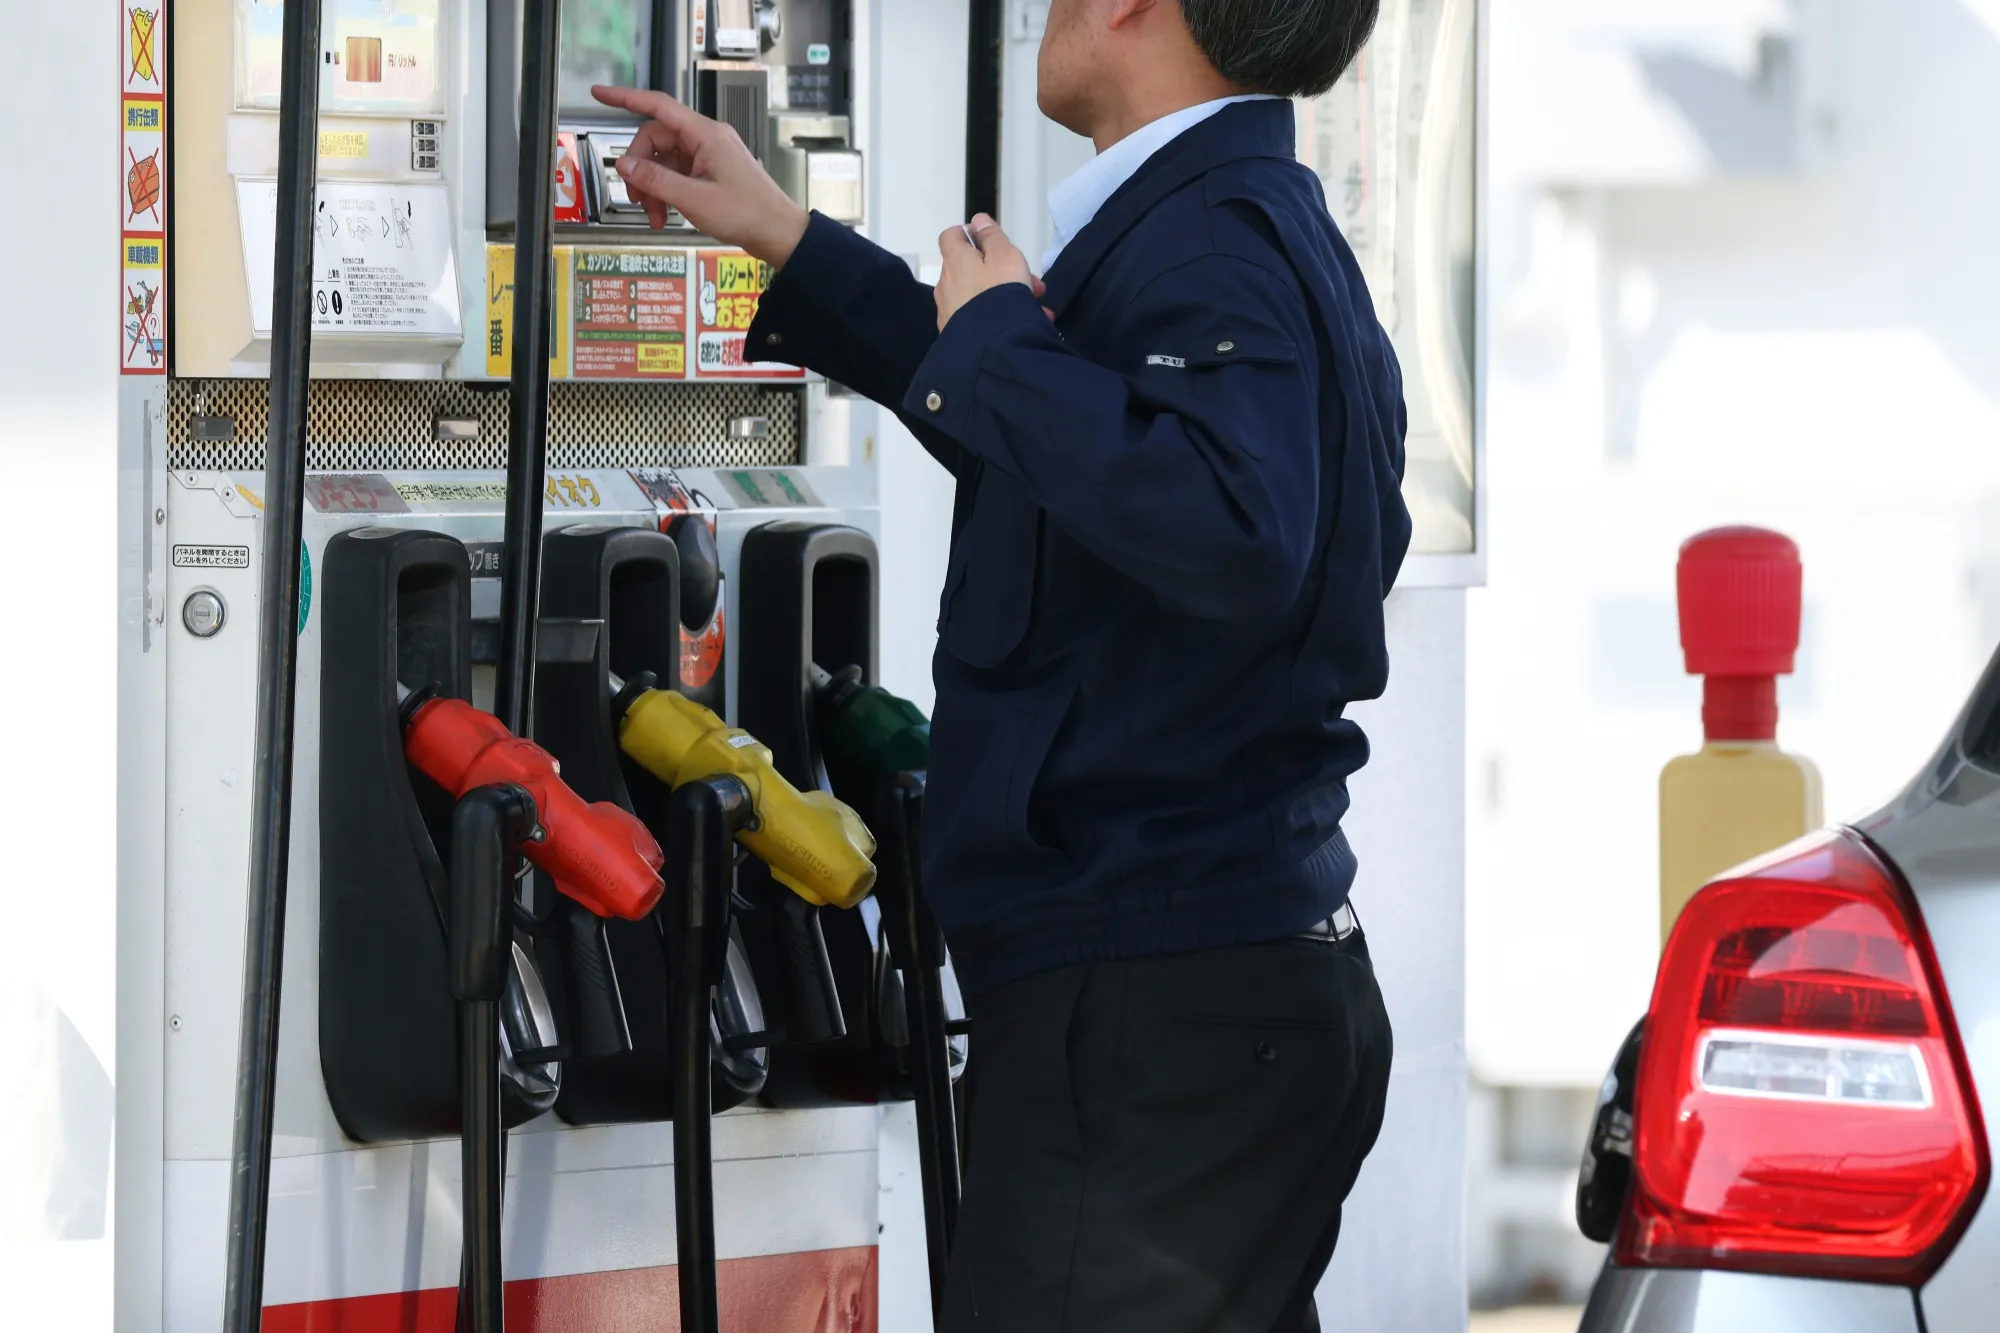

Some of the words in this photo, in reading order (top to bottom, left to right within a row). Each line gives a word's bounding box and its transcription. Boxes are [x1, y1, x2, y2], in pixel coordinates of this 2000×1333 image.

[128, 107, 159, 127] 携行缶類
[128, 245, 159, 265] 車載機類
[720, 261, 755, 290] レシート
[585, 282, 591, 297] 1
[630, 283, 636, 299] 3
[585, 305, 591, 320] 2
[629, 307, 636, 322] 4
[716, 295, 760, 329] お忘
[305, 475, 390, 510] レギュラー
[545, 474, 601, 508] イオク
[176, 548, 247, 557] パネルを開閉するときは
[176, 556, 247, 565] ノズルを外してください
